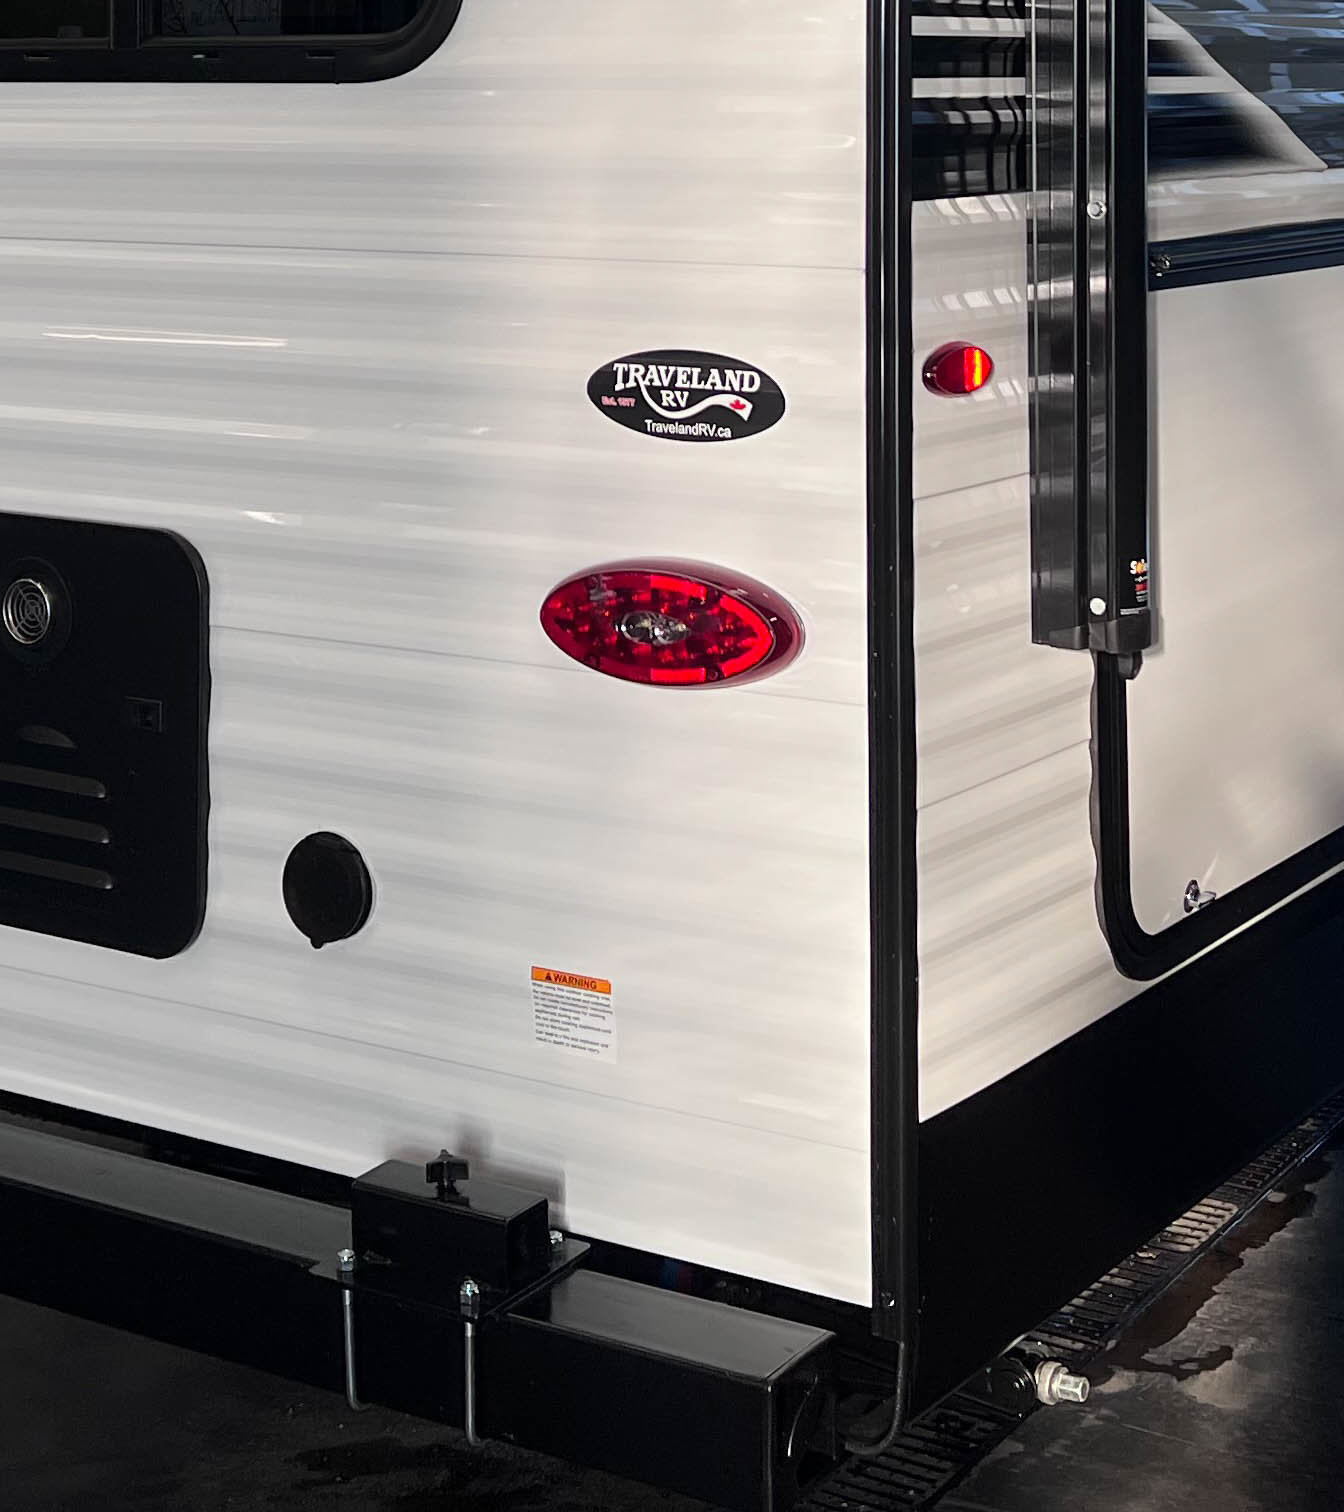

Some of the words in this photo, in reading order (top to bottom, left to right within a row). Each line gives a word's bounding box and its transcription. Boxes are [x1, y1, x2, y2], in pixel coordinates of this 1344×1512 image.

[613, 363, 761, 393] TRAVELAND
[660, 390, 689, 407] RV
[645, 419, 732, 438] TravelandRV.ca
[553, 972, 597, 989] WARNING
